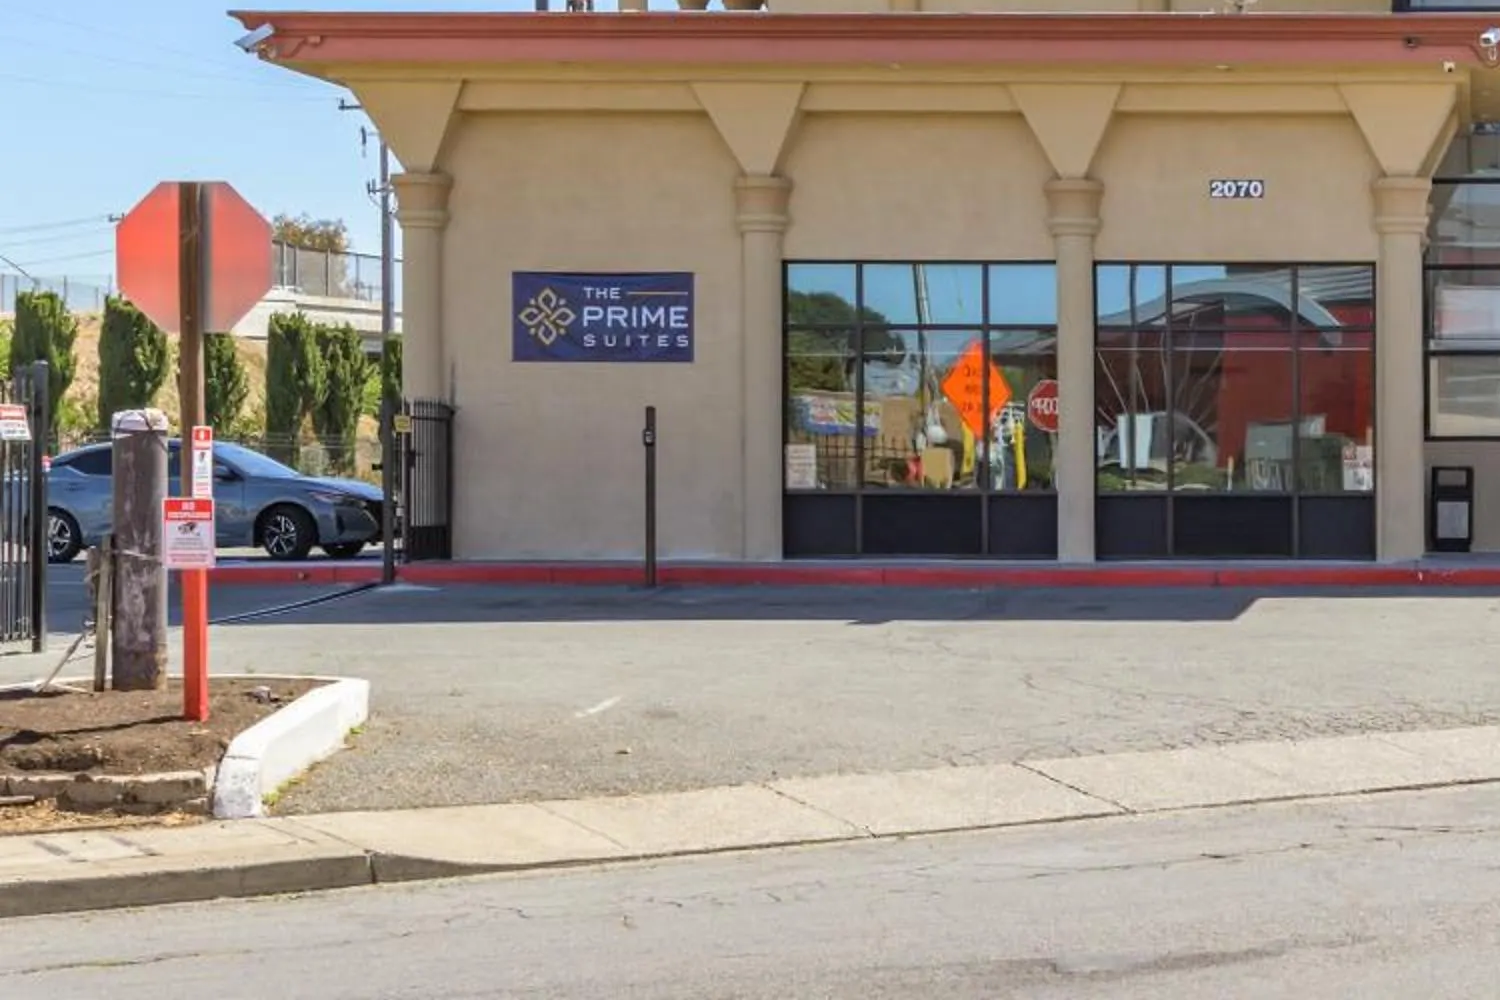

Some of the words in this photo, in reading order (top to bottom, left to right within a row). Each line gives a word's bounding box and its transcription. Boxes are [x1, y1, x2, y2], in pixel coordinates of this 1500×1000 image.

[1211, 181, 1262, 197] 2070
[583, 287, 621, 299] THE
[583, 306, 689, 328] PRIME
[583, 335, 689, 347] SUITES
